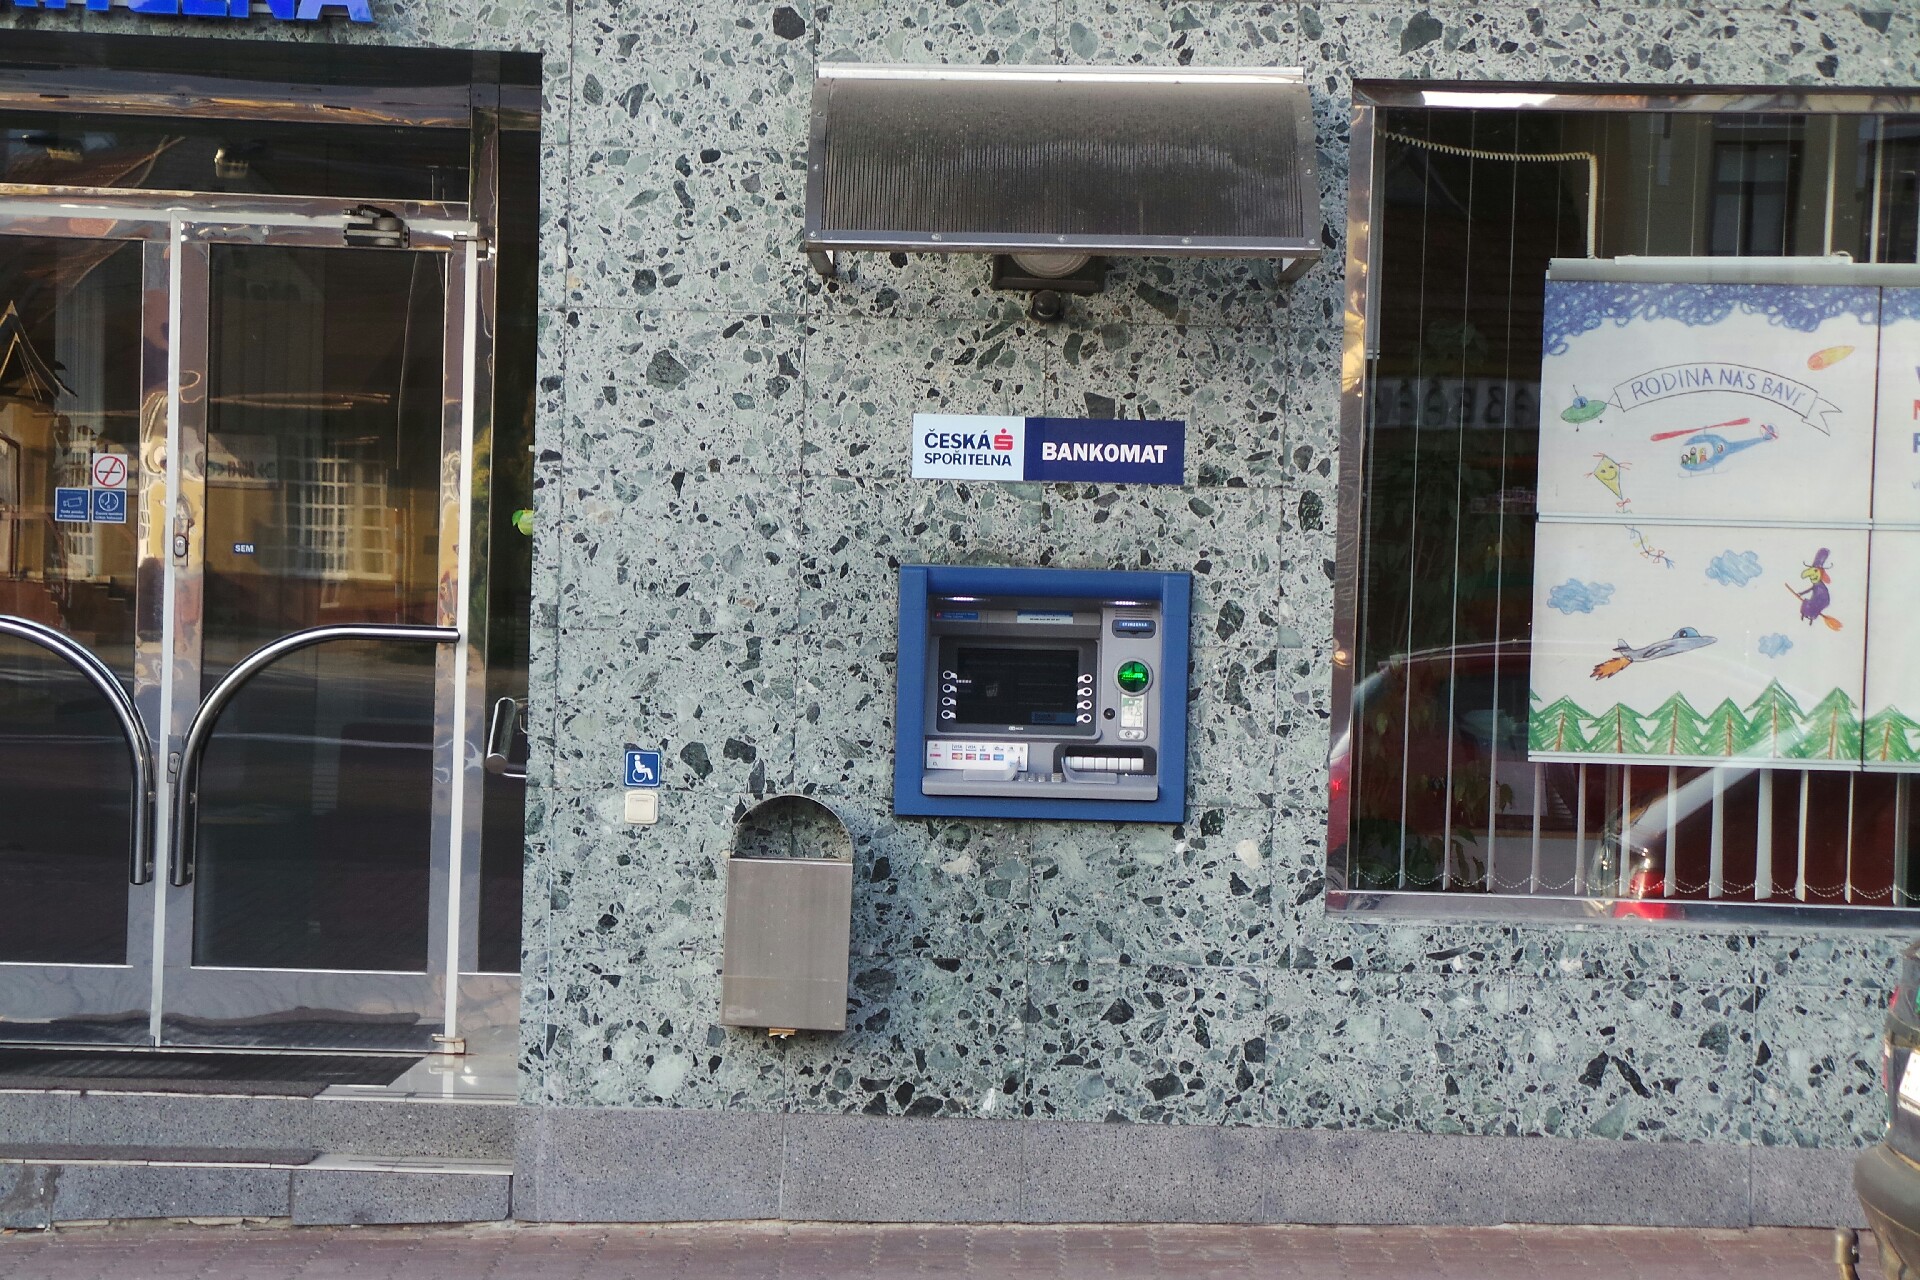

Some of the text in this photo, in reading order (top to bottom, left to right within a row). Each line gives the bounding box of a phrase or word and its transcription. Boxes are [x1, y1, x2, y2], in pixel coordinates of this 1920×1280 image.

[1631, 368, 1714, 400] RODINA
[924, 429, 992, 450] ČESKÁ
[924, 451, 1012, 466] SPOŘITELNA
[1042, 442, 1168, 464] BANKOMAT
[235, 544, 254, 552] SEM
